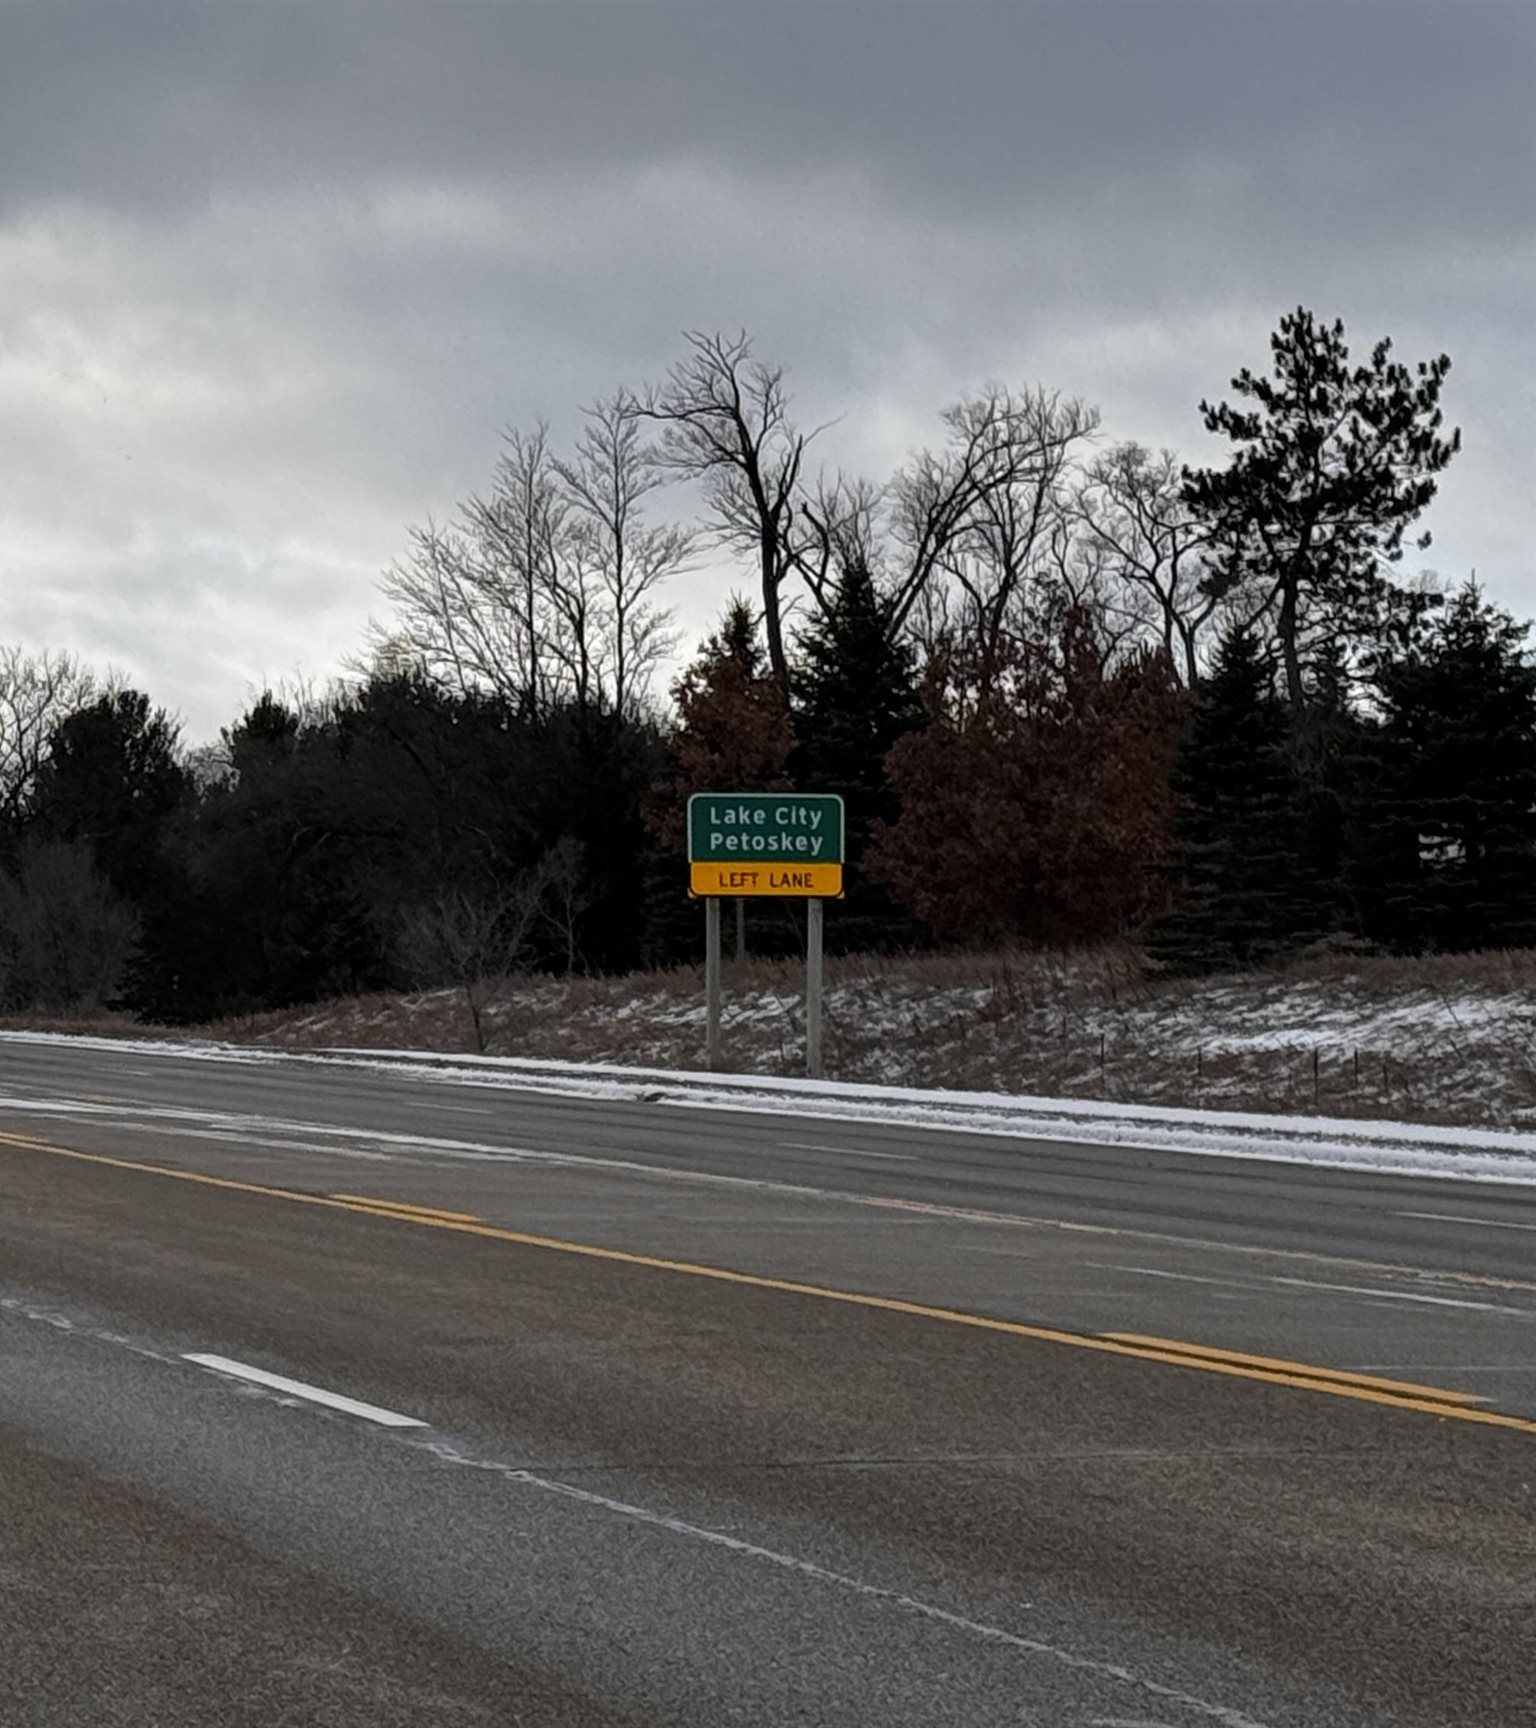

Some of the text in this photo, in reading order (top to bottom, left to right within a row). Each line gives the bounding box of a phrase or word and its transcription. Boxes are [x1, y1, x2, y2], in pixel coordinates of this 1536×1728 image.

[710, 805, 822, 830] Lake City
[710, 831, 823, 857] Petoskey
[719, 871, 814, 888] LEFT LANE
